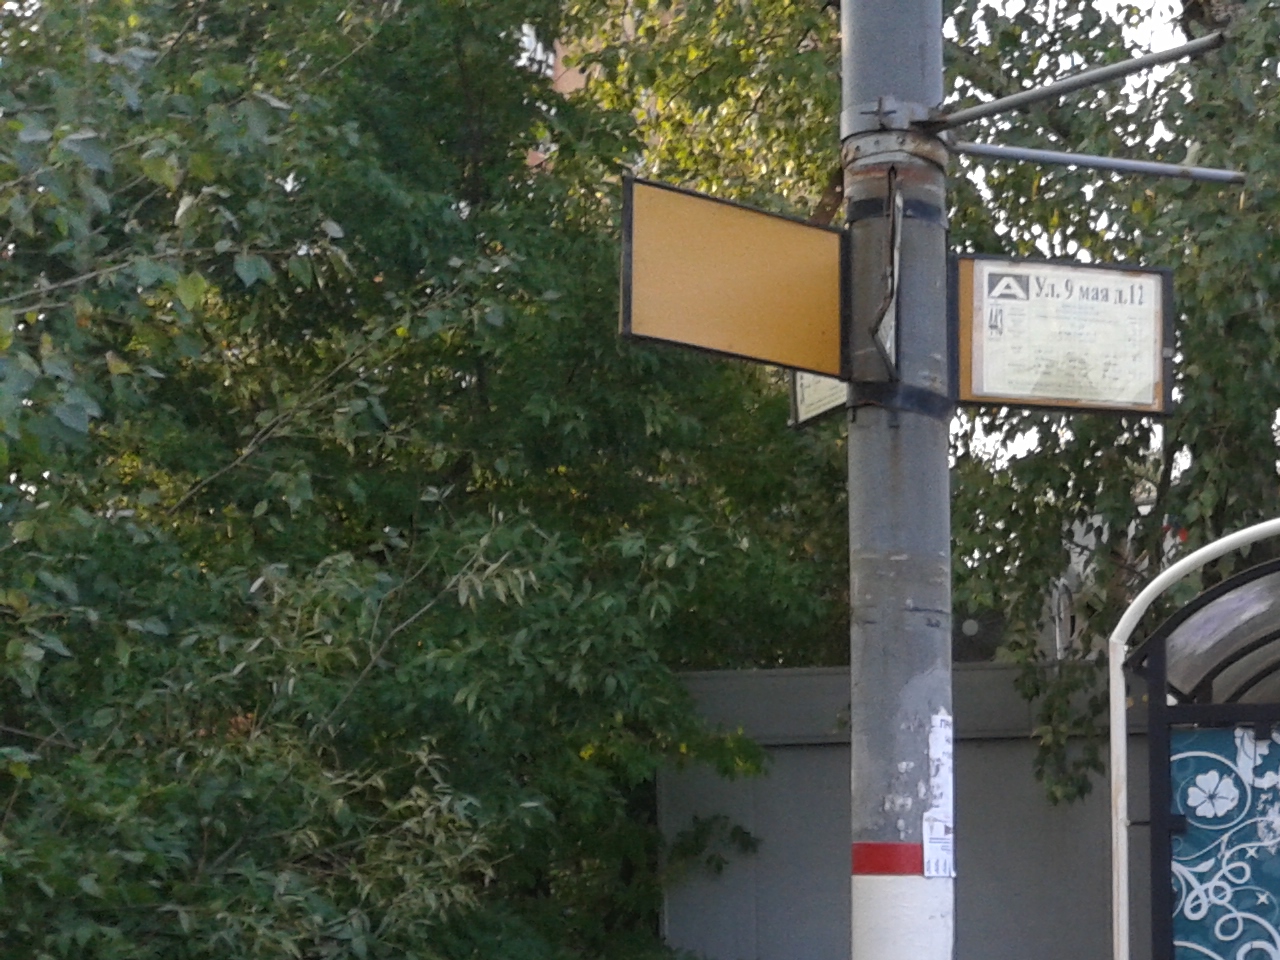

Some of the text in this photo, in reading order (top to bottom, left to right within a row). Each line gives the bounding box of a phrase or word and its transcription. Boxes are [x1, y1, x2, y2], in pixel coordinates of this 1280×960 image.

[1034, 275, 1060, 299] Ул.
[1064, 278, 1074, 299] 9
[1078, 284, 1109, 303] мая
